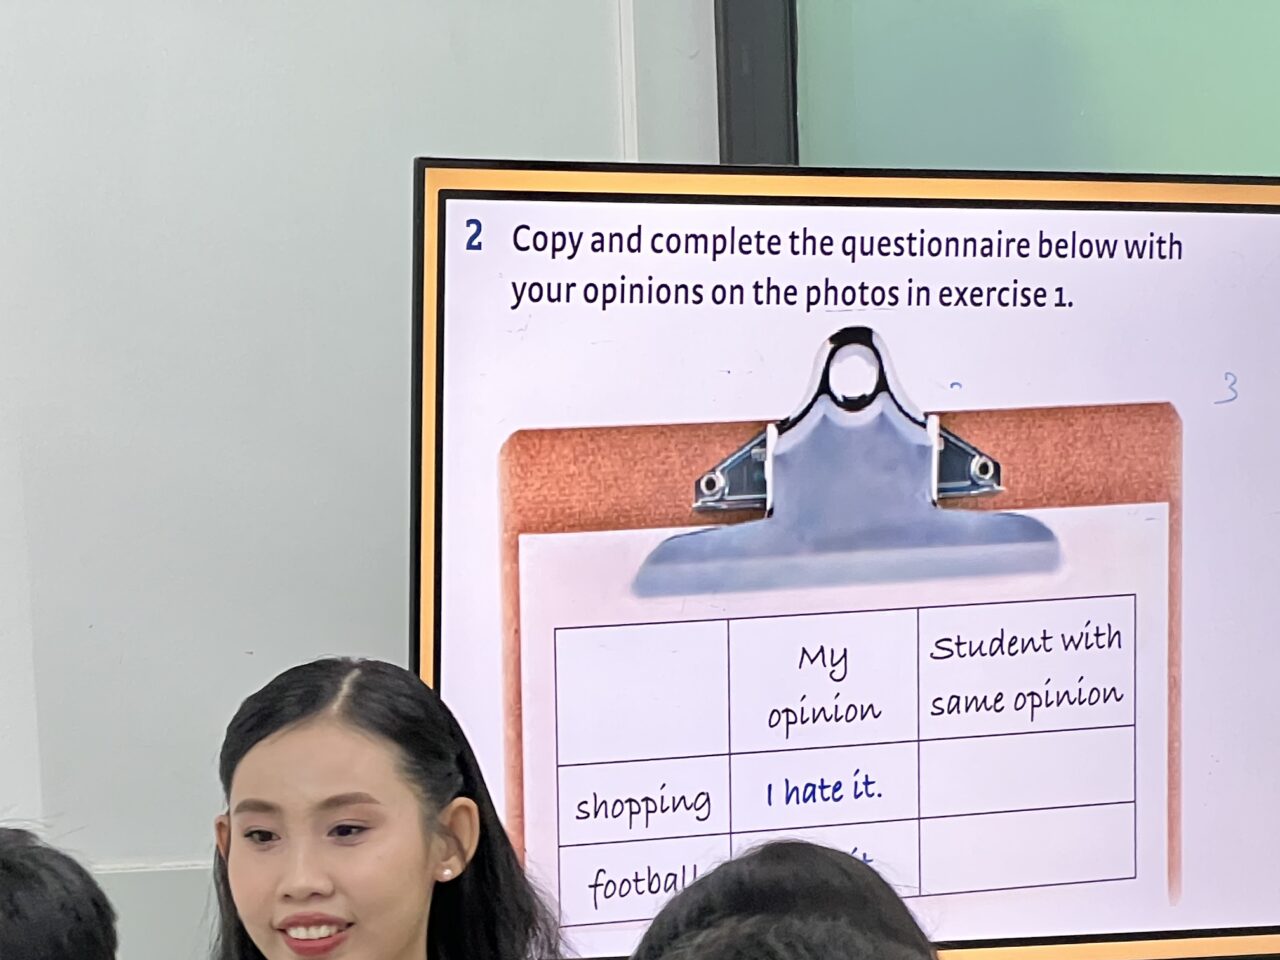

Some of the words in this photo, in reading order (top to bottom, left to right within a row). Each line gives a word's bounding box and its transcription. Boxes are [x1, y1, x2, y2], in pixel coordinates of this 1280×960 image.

[466, 219, 482, 250] 2
[512, 224, 583, 259] Copy
[590, 225, 642, 253] and
[651, 226, 781, 261] complete
[789, 227, 833, 256] the
[842, 229, 1030, 263] questionnaire
[1038, 231, 1117, 259] below
[1124, 231, 1183, 260] with
[511, 280, 576, 310] your
[583, 275, 704, 310] opinions
[712, 284, 744, 305] on
[753, 277, 798, 306] the
[806, 278, 899, 312] photos
[908, 278, 930, 307] in
[939, 279, 1047, 307] exercise
[1054, 286, 1073, 307] 1.
[929, 628, 1053, 660] Student
[1061, 620, 1122, 650] with
[799, 645, 848, 683] My
[768, 692, 882, 740] opinion
[930, 691, 1005, 716] same
[1013, 676, 1124, 722] opinion
[575, 783, 711, 829] shopping
[767, 783, 772, 807] I
[784, 777, 844, 805] hate
[853, 768, 882, 799] it.
